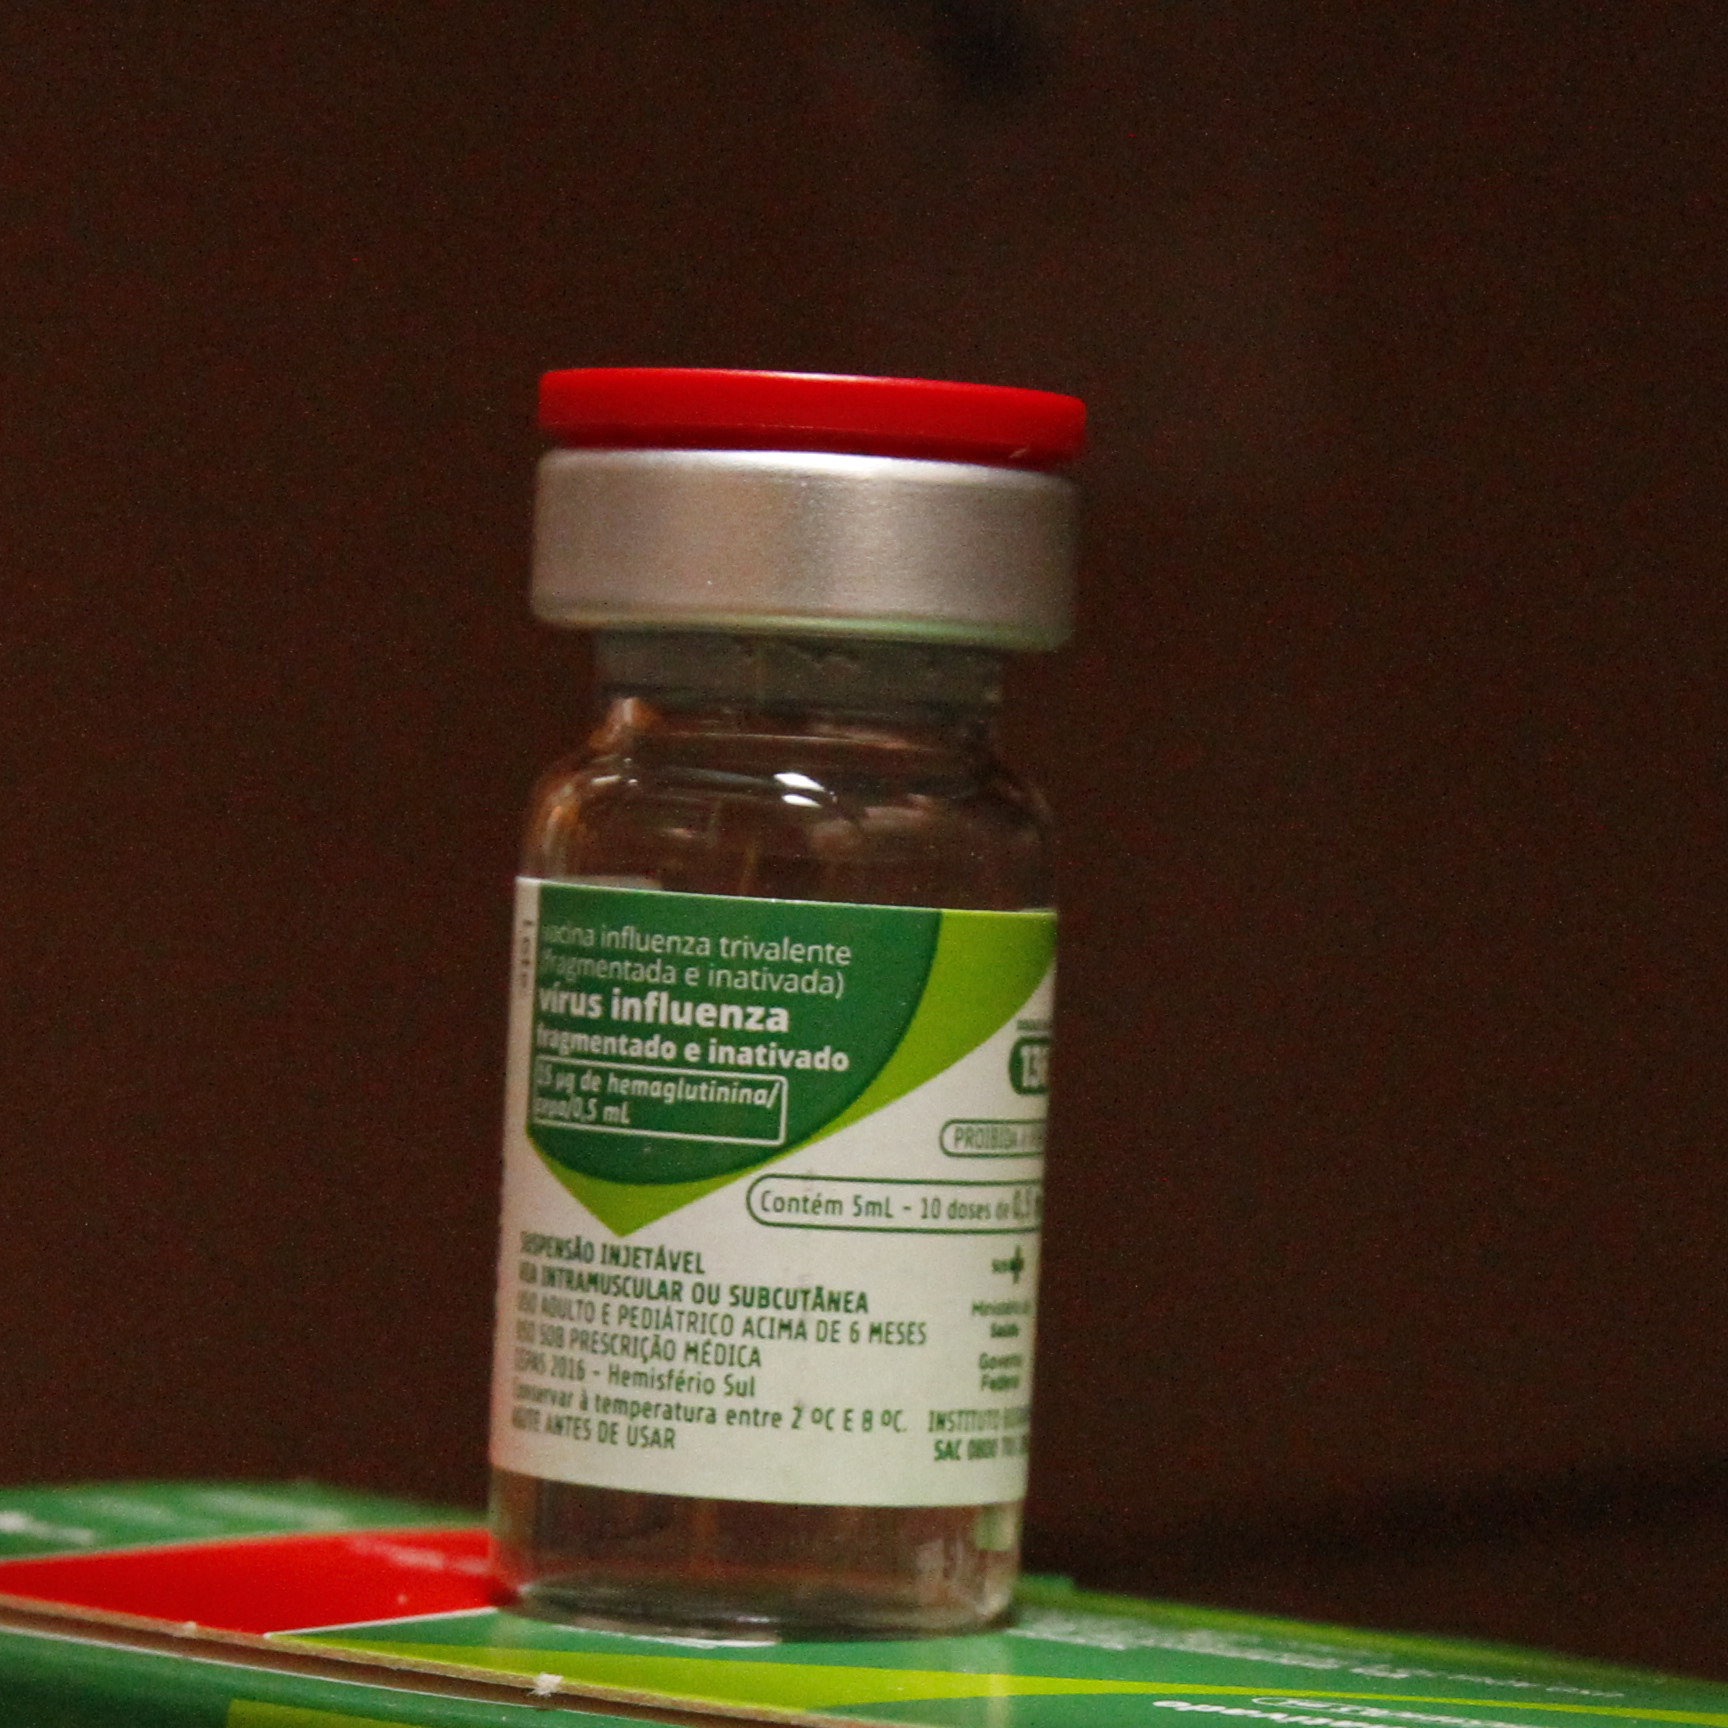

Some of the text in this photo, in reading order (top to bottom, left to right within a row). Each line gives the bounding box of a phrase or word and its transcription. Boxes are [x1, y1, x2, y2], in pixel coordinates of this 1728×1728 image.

[600, 925, 710, 957] influenza
[719, 935, 852, 966] trivalente
[684, 965, 701, 986] e
[707, 966, 845, 1000] inativada)
[538, 981, 790, 1033] vírus influenza
[537, 1022, 850, 1071] fragmentado e inativado
[580, 1068, 602, 1092] de
[607, 1071, 780, 1109] hemaglutinina/
[602, 1101, 631, 1124] mL
[760, 1189, 843, 1216] Contém
[852, 1194, 894, 1219] 5mL
[920, 1196, 942, 1221] 10
[947, 1198, 992, 1221] doses
[600, 1243, 706, 1275] INJETÁVEL
[540, 1265, 683, 1302] INTRAMUSCULAR
[691, 1281, 721, 1304] OU
[728, 1283, 870, 1314] SUBCUTÂNEA
[602, 1302, 611, 1326] E
[617, 1304, 734, 1337] PEDIÁTRICO
[741, 1314, 808, 1341] ACIMA
[816, 1319, 842, 1343] DE
[848, 1320, 861, 1344] 6
[868, 1321, 928, 1346] MESES
[569, 1328, 677, 1364] PRESCRIÇÃO
[683, 1339, 762, 1368] MÉDICA
[608, 1363, 716, 1395] Hemisfério
[723, 1373, 756, 1398] Sul
[594, 1392, 717, 1424] temperatura
[725, 1408, 783, 1429] entre
[790, 1406, 804, 1430] 2
[842, 1408, 854, 1432] E
[861, 1409, 874, 1433] 8
[597, 1420, 620, 1445] DE
[627, 1424, 676, 1450] USAR
